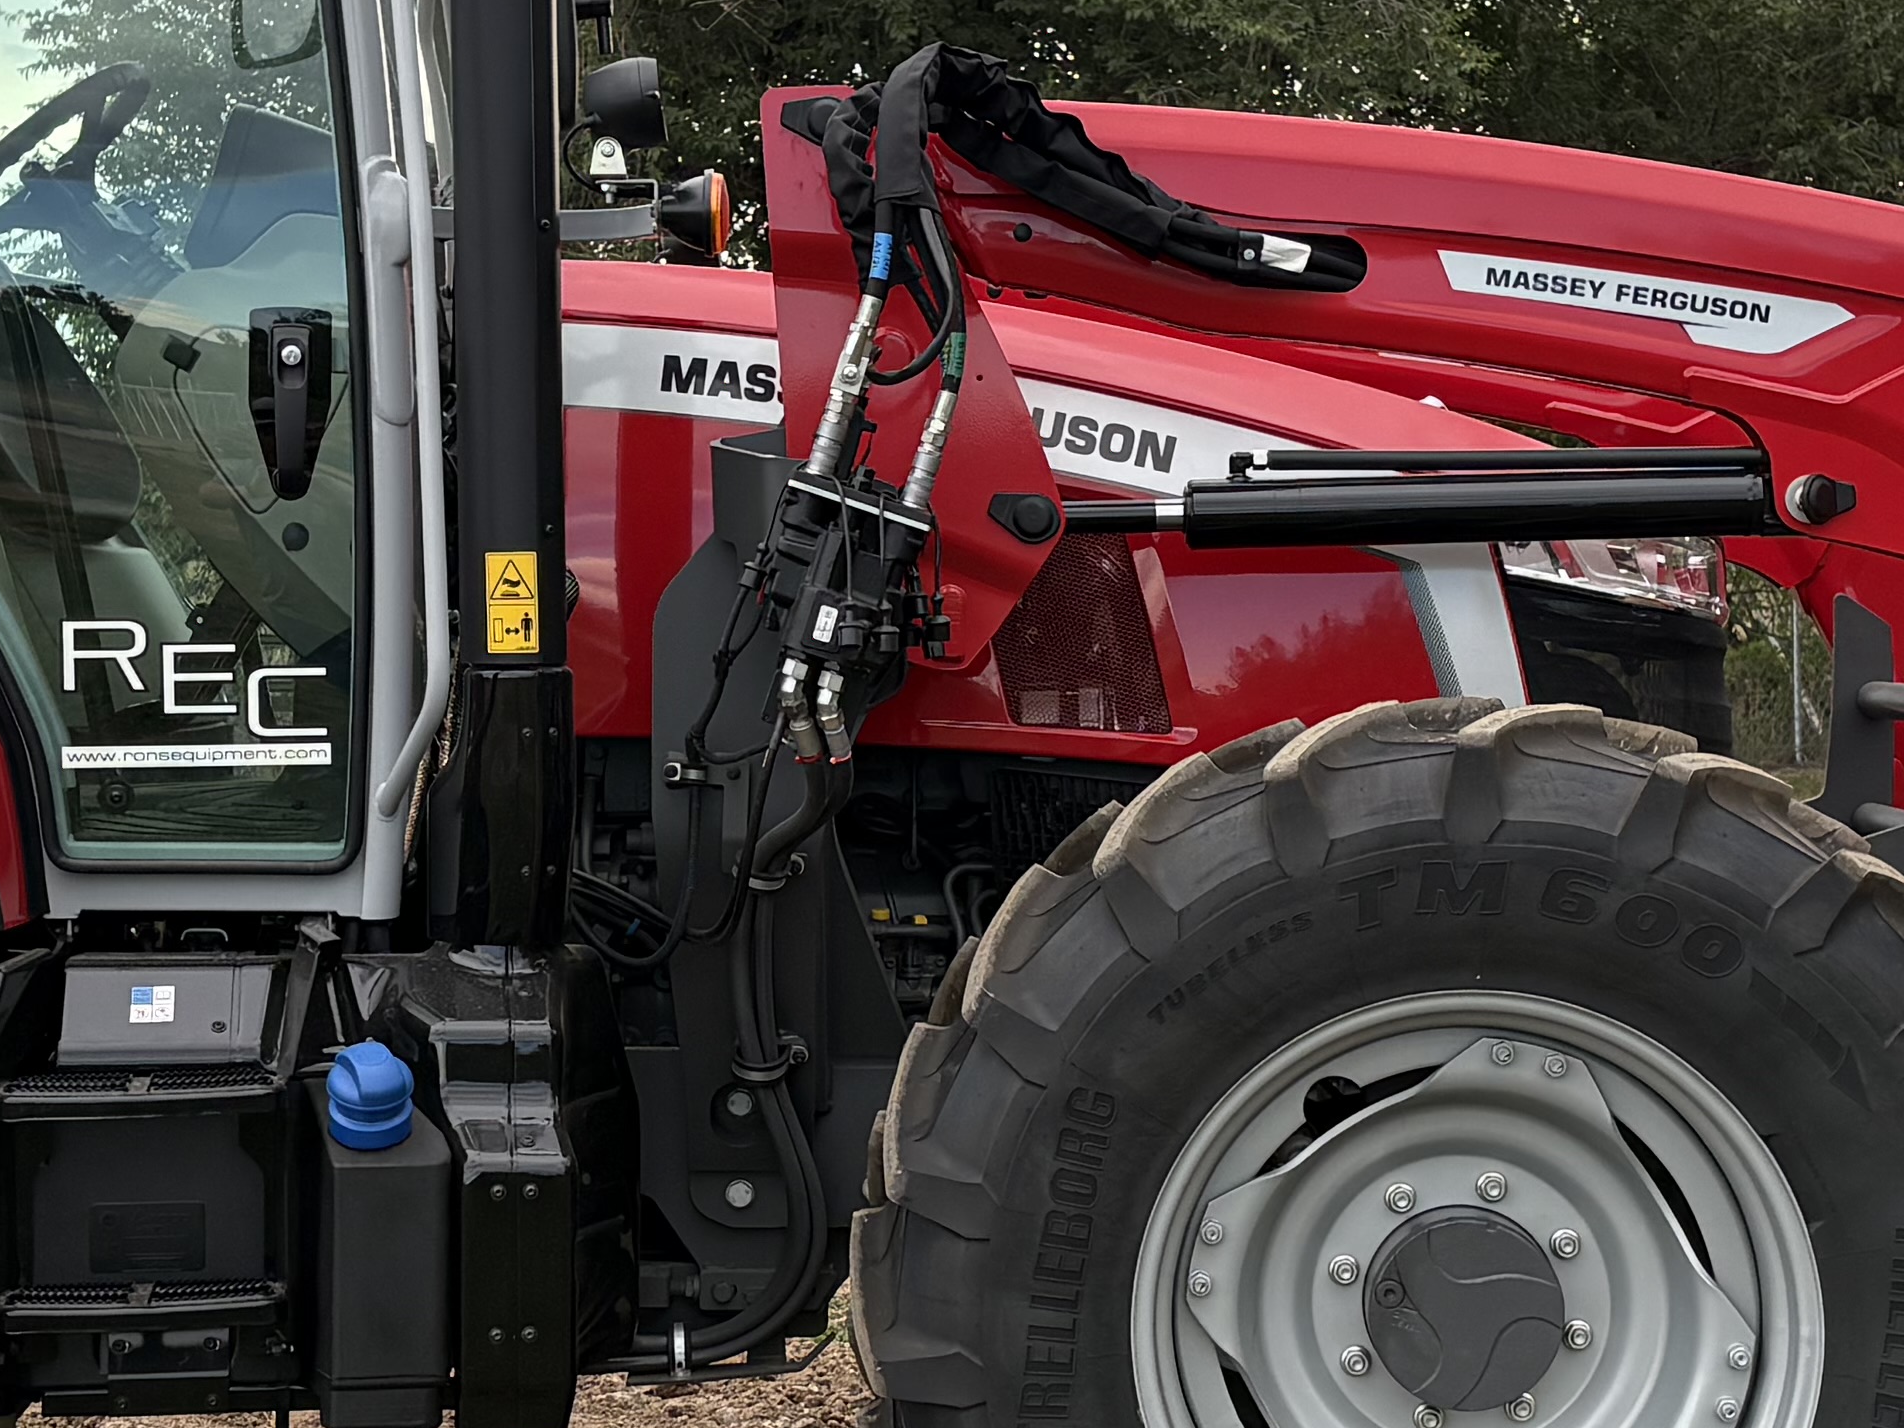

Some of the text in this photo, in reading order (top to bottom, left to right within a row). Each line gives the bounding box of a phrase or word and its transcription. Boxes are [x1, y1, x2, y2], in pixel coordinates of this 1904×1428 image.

[1485, 267, 1772, 324] MASSEY FERGUSON
[660, 354, 784, 403] MAS
[62, 620, 328, 737] REC
[66, 747, 328, 763] www.ronsequipment.com
[1338, 859, 1745, 978] TM 600
[1146, 910, 1314, 1026] TUBELESS
